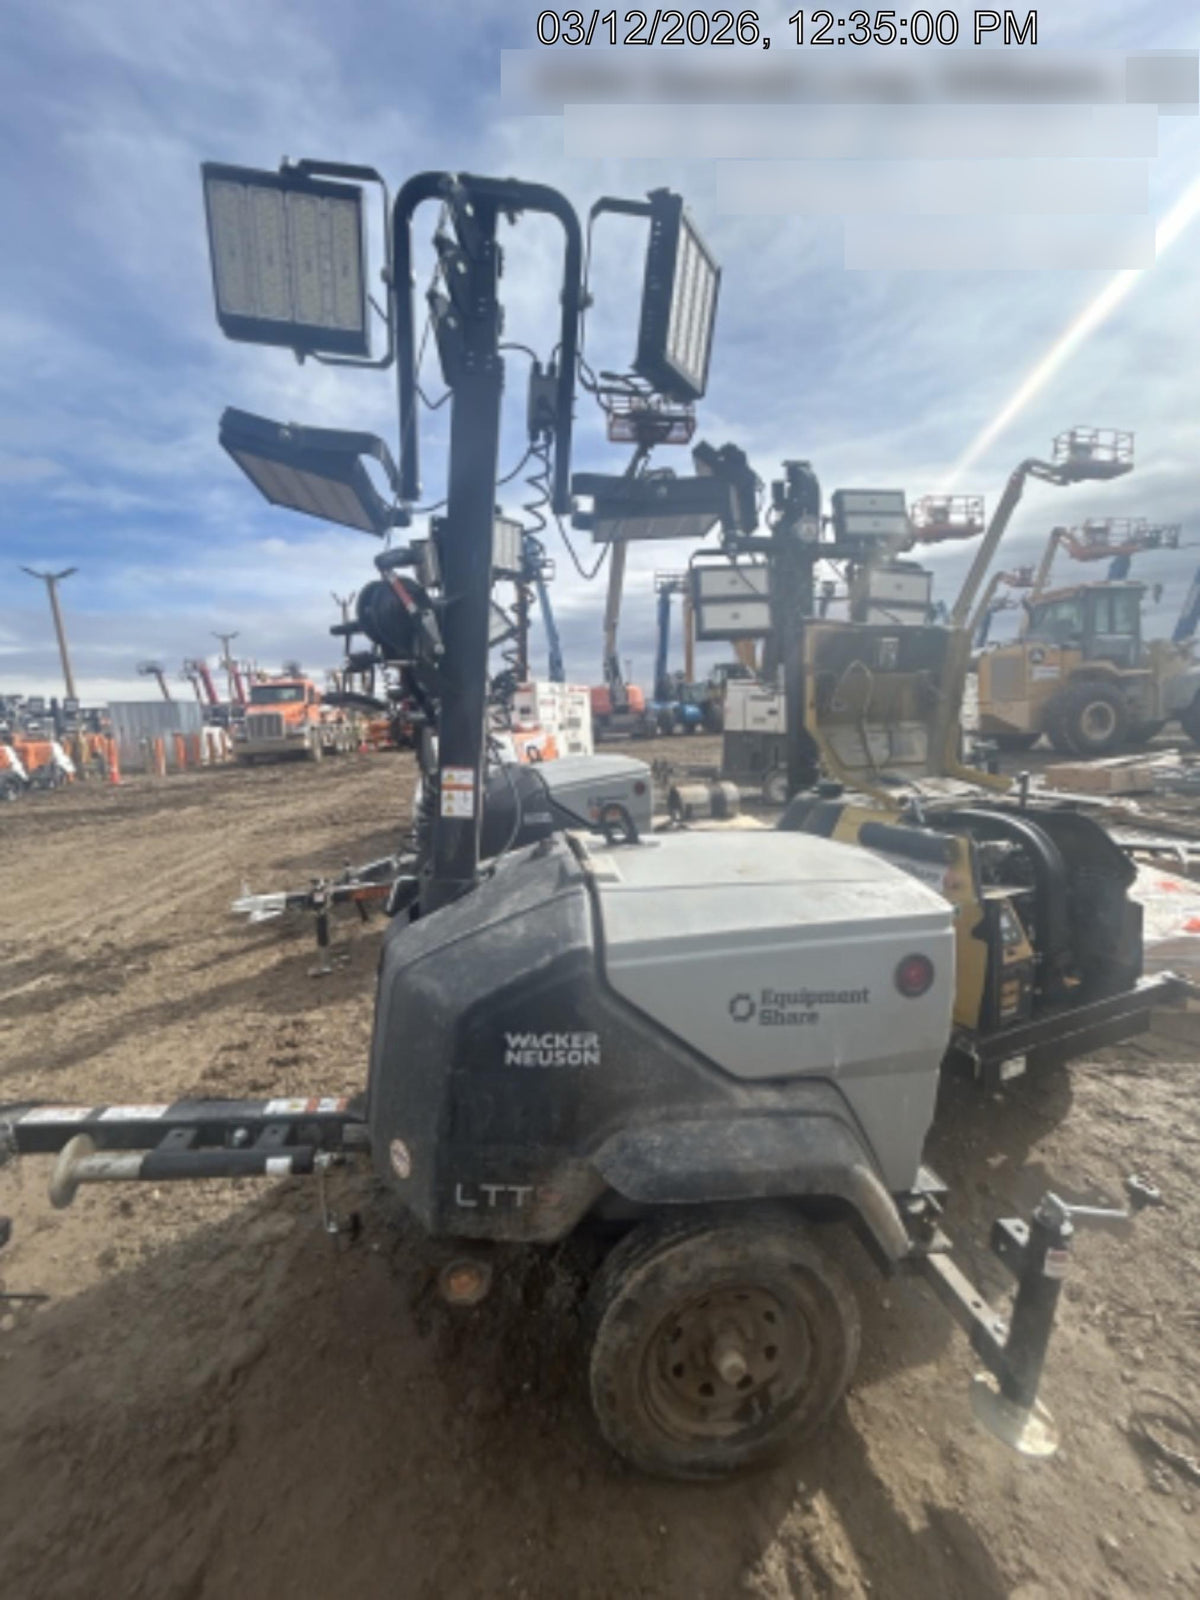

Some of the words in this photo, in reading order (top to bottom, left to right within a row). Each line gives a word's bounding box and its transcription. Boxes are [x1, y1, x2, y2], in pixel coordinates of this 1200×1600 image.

[761, 987, 870, 1009] Equipment
[759, 1009, 819, 1026] Share
[504, 1032, 601, 1048] WACKER
[504, 1050, 602, 1066] NEUSON
